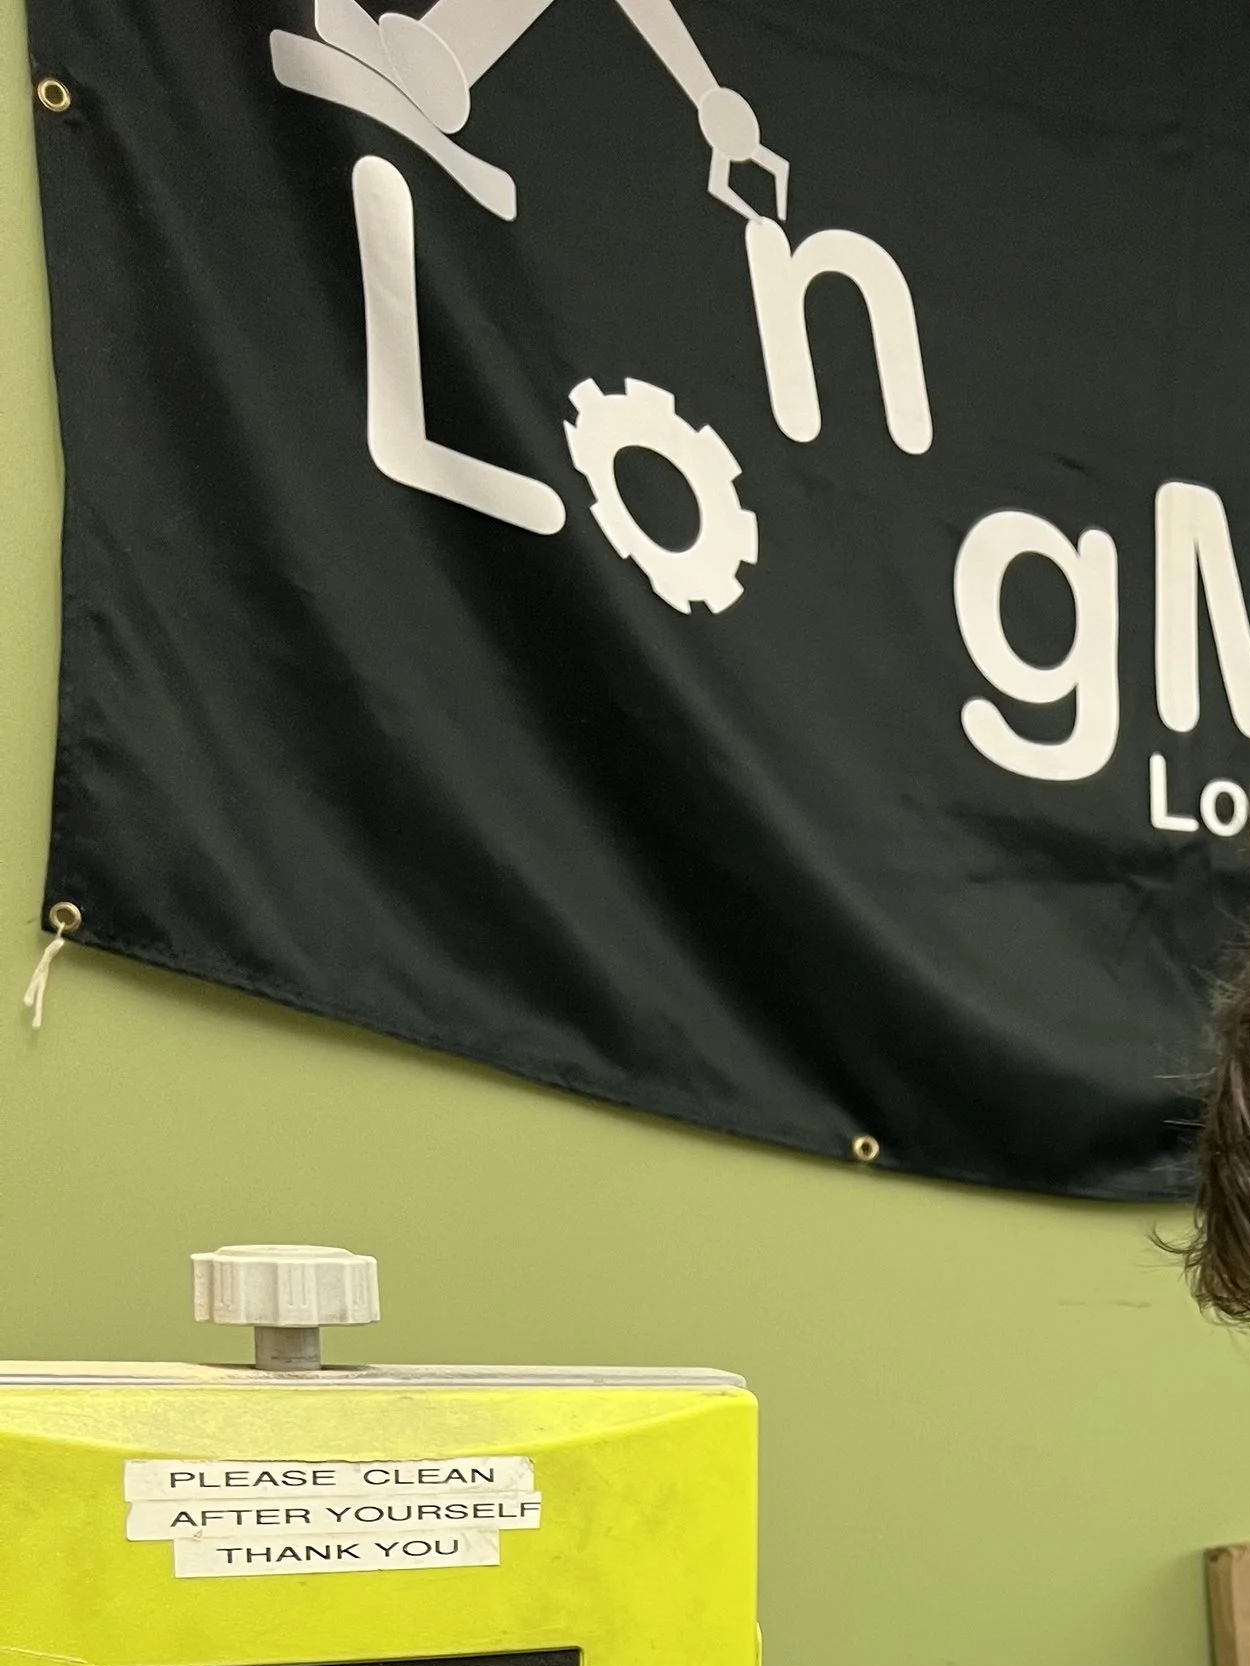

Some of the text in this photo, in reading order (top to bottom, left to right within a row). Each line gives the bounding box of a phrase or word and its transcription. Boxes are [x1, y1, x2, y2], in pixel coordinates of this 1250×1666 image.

[169, 1466, 495, 1489] PLEASE CLEAN
[171, 1500, 541, 1528] AFTER YOURSELF
[217, 1539, 460, 1565] THANK YOU
